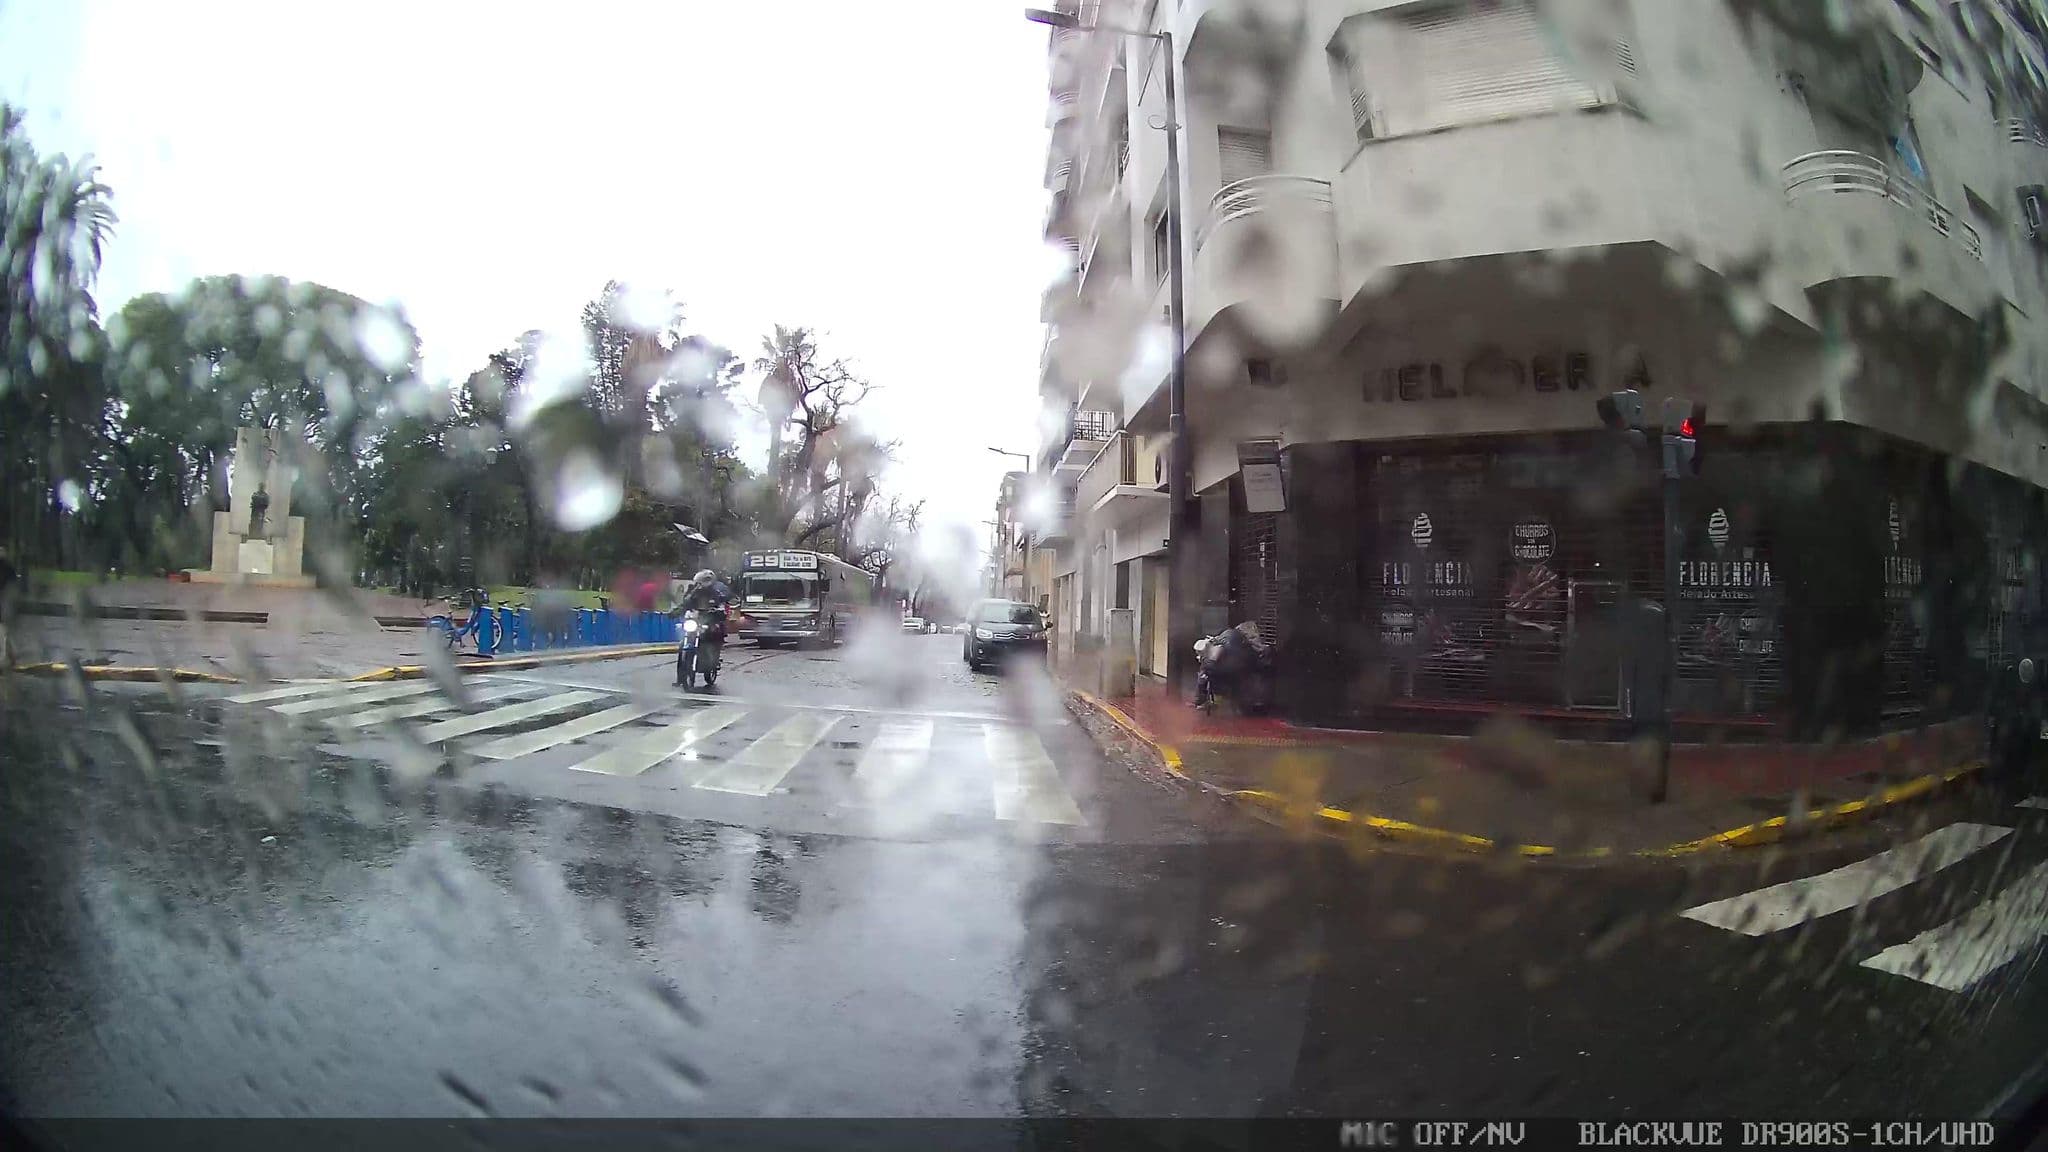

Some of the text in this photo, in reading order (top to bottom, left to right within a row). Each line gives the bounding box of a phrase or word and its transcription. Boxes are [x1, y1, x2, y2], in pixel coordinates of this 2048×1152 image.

[1363, 352, 1652, 401] HELERA
[750, 555, 778, 567] 29
[1383, 561, 1474, 585] FLOENCIA
[1680, 561, 1771, 586] FLORENCIA
